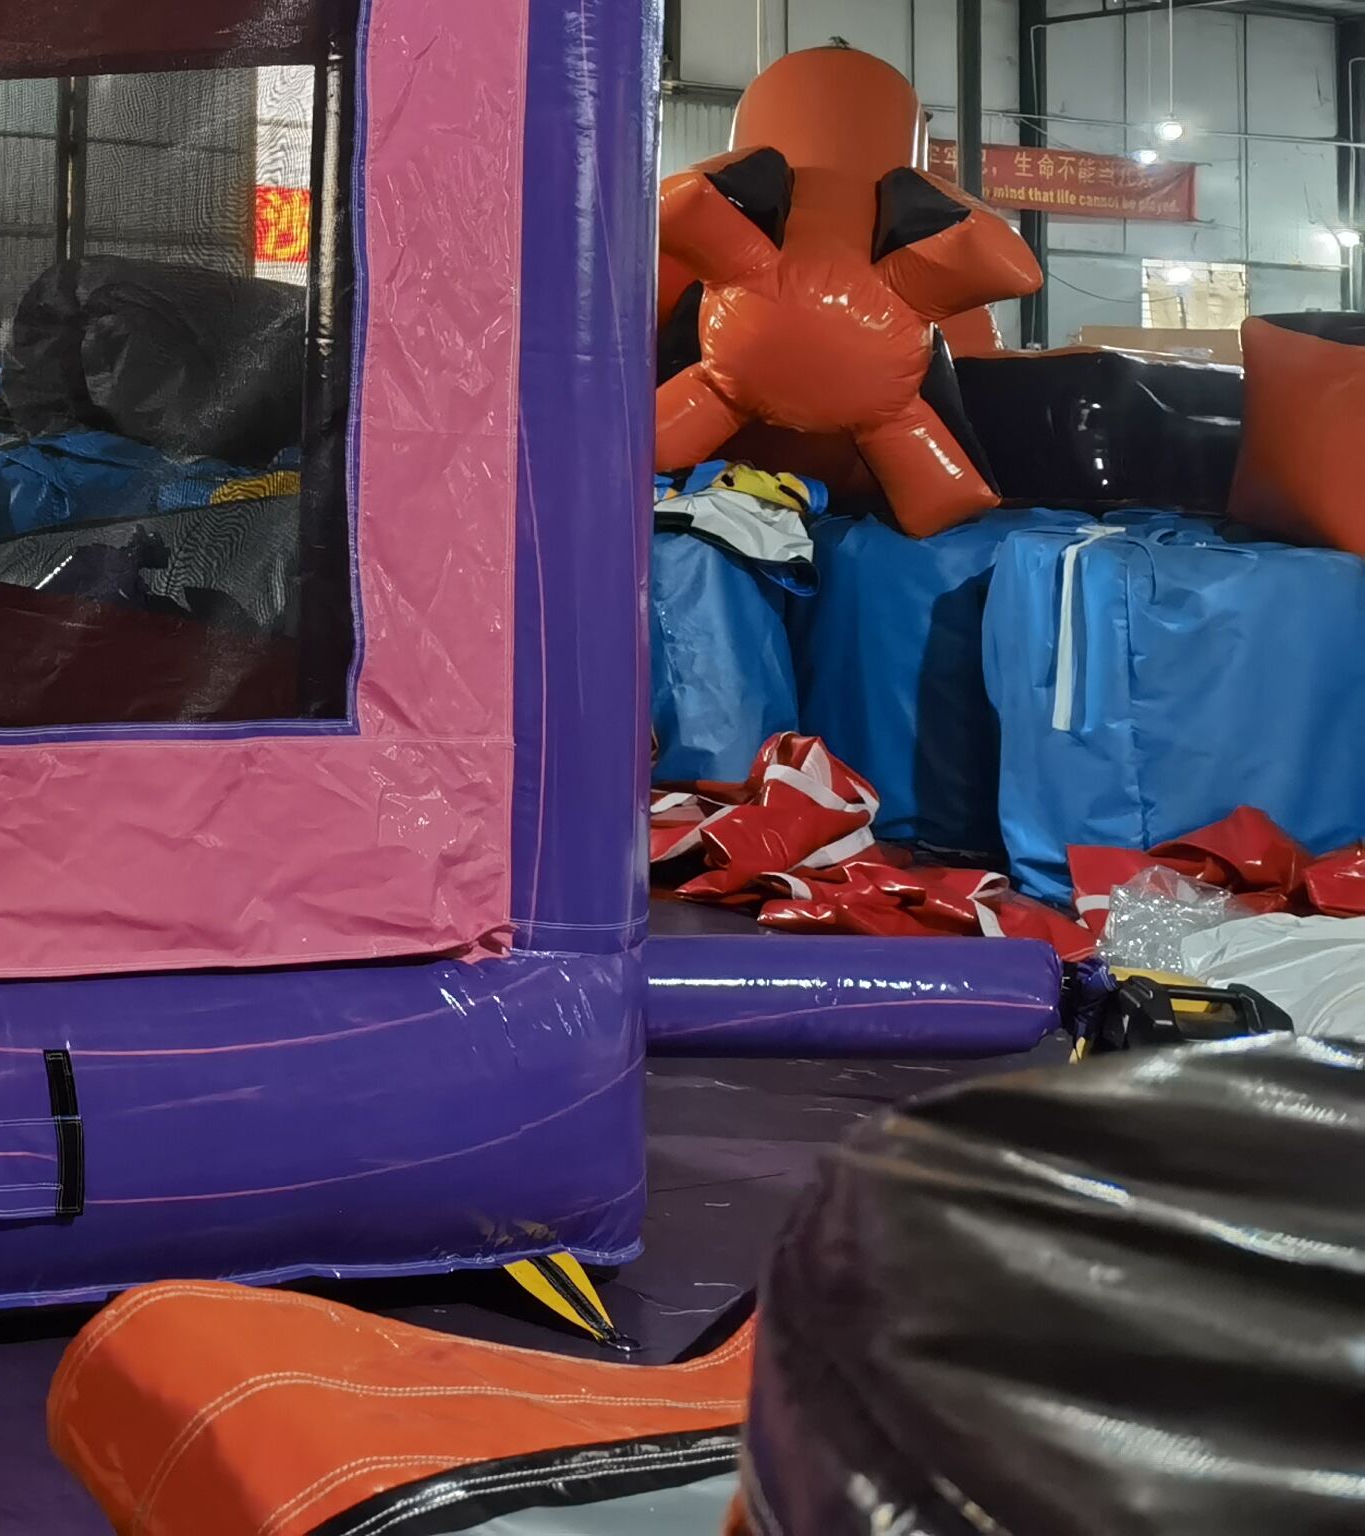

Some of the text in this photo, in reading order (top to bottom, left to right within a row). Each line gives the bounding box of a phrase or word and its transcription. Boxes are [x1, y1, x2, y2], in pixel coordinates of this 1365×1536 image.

[993, 185, 1026, 200] mind
[1029, 186, 1054, 203] that
[1057, 188, 1076, 206] life
